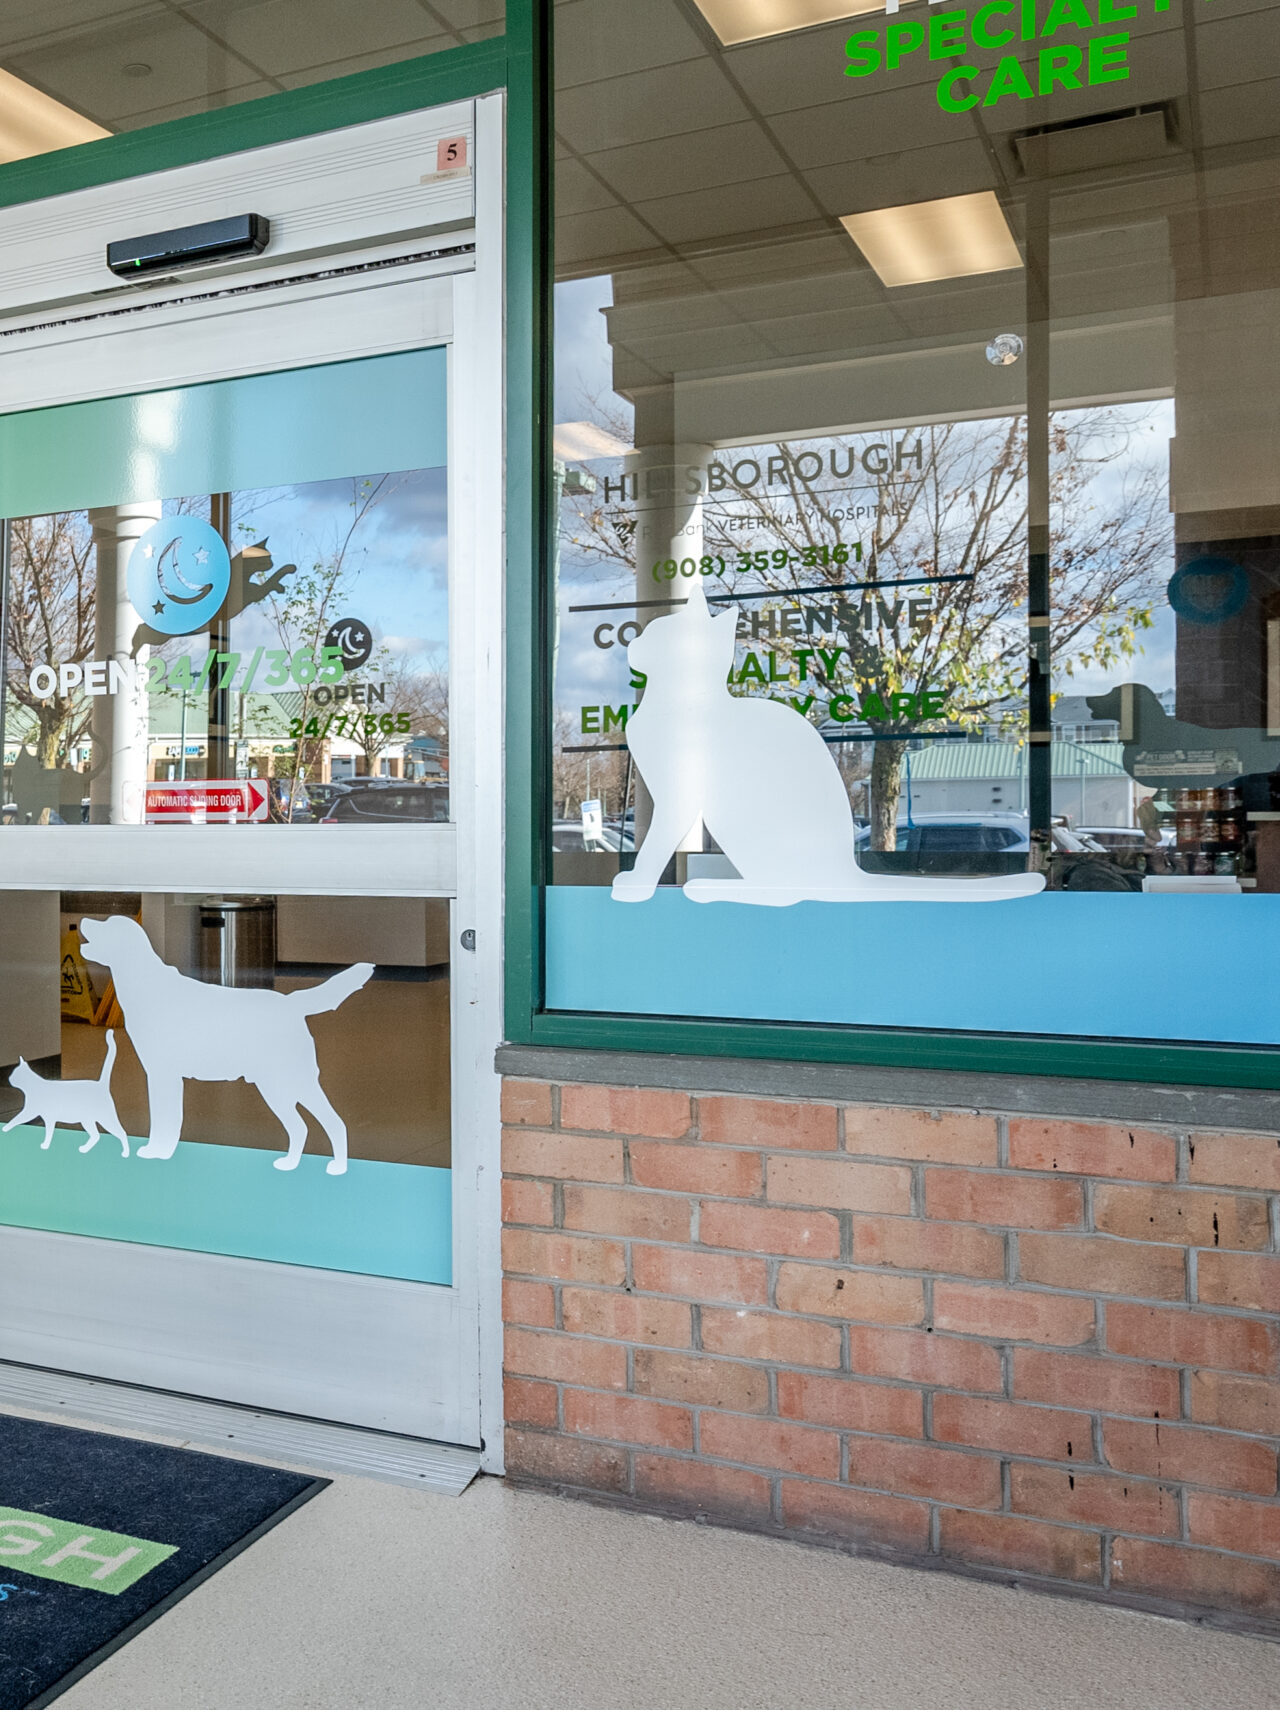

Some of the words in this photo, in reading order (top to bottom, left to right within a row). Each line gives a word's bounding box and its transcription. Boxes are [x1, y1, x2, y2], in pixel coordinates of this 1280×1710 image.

[843, 0, 1215, 77] SPECIAL
[936, 31, 1130, 114] CARE
[447, 143, 458, 162] 5
[717, 510, 814, 532] VETERINARY
[821, 501, 910, 524] HOSPITALS
[651, 555, 726, 584] (908)
[735, 541, 863, 574] 359-3161
[28, 659, 138, 699] OPEN
[144, 645, 346, 696] 24/7/365
[314, 683, 386, 707] OPEN
[829, 689, 948, 723] CARE
[289, 712, 411, 739] 24/7/365
[148, 795, 188, 807] AUTOMATIC
[189, 794, 219, 806] SLIDING
[220, 794, 242, 806] DOOR
